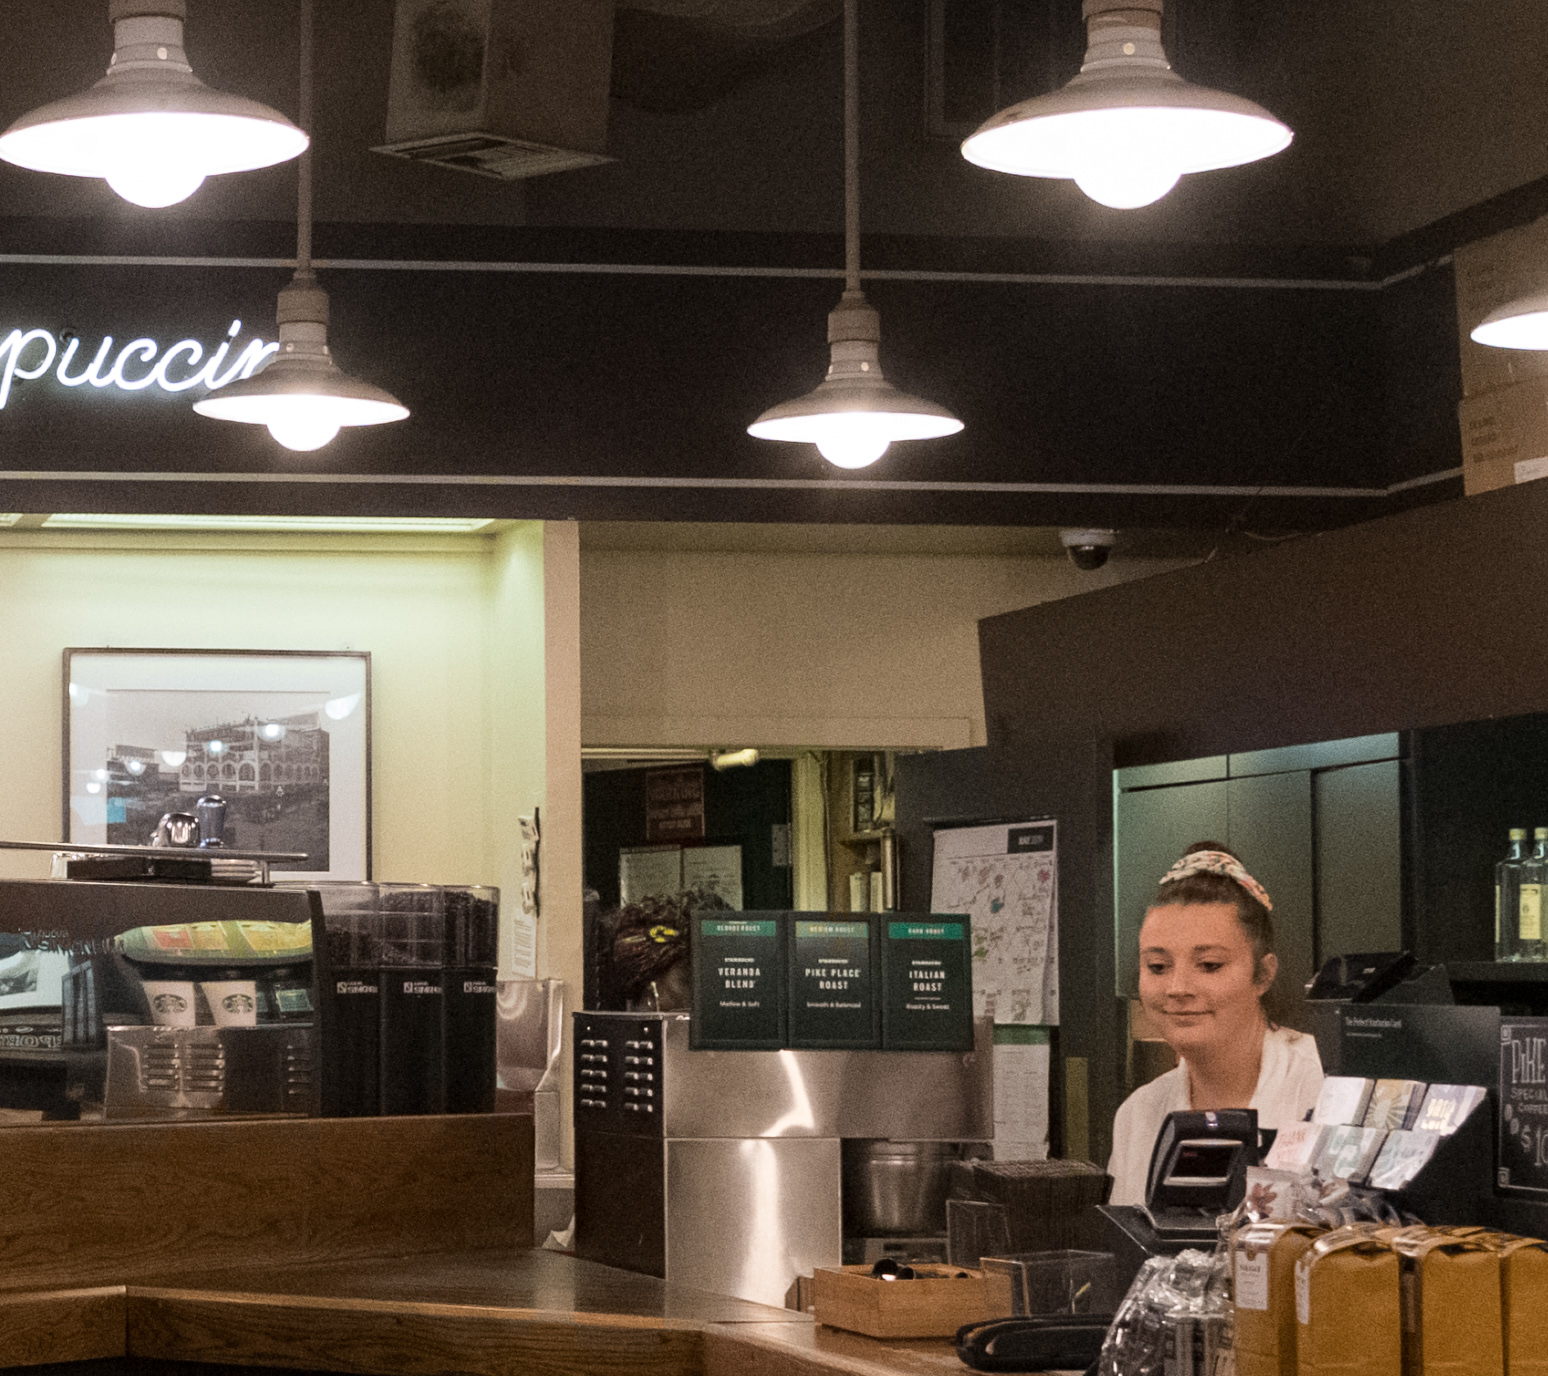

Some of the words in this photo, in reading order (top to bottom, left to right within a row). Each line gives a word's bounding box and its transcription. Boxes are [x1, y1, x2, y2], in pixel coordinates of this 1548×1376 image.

[718, 967, 761, 977] VERANDA
[805, 969, 827, 978] PIKE
[830, 969, 860, 978] PLACE
[909, 971, 945, 980] ITALIAN
[724, 980, 756, 989] BLEND
[819, 981, 848, 990] ROAST
[913, 983, 942, 992] ROAST
[1511, 1087, 1548, 1101] SPECIAL
[1518, 1103, 1548, 1115] COFFEE
